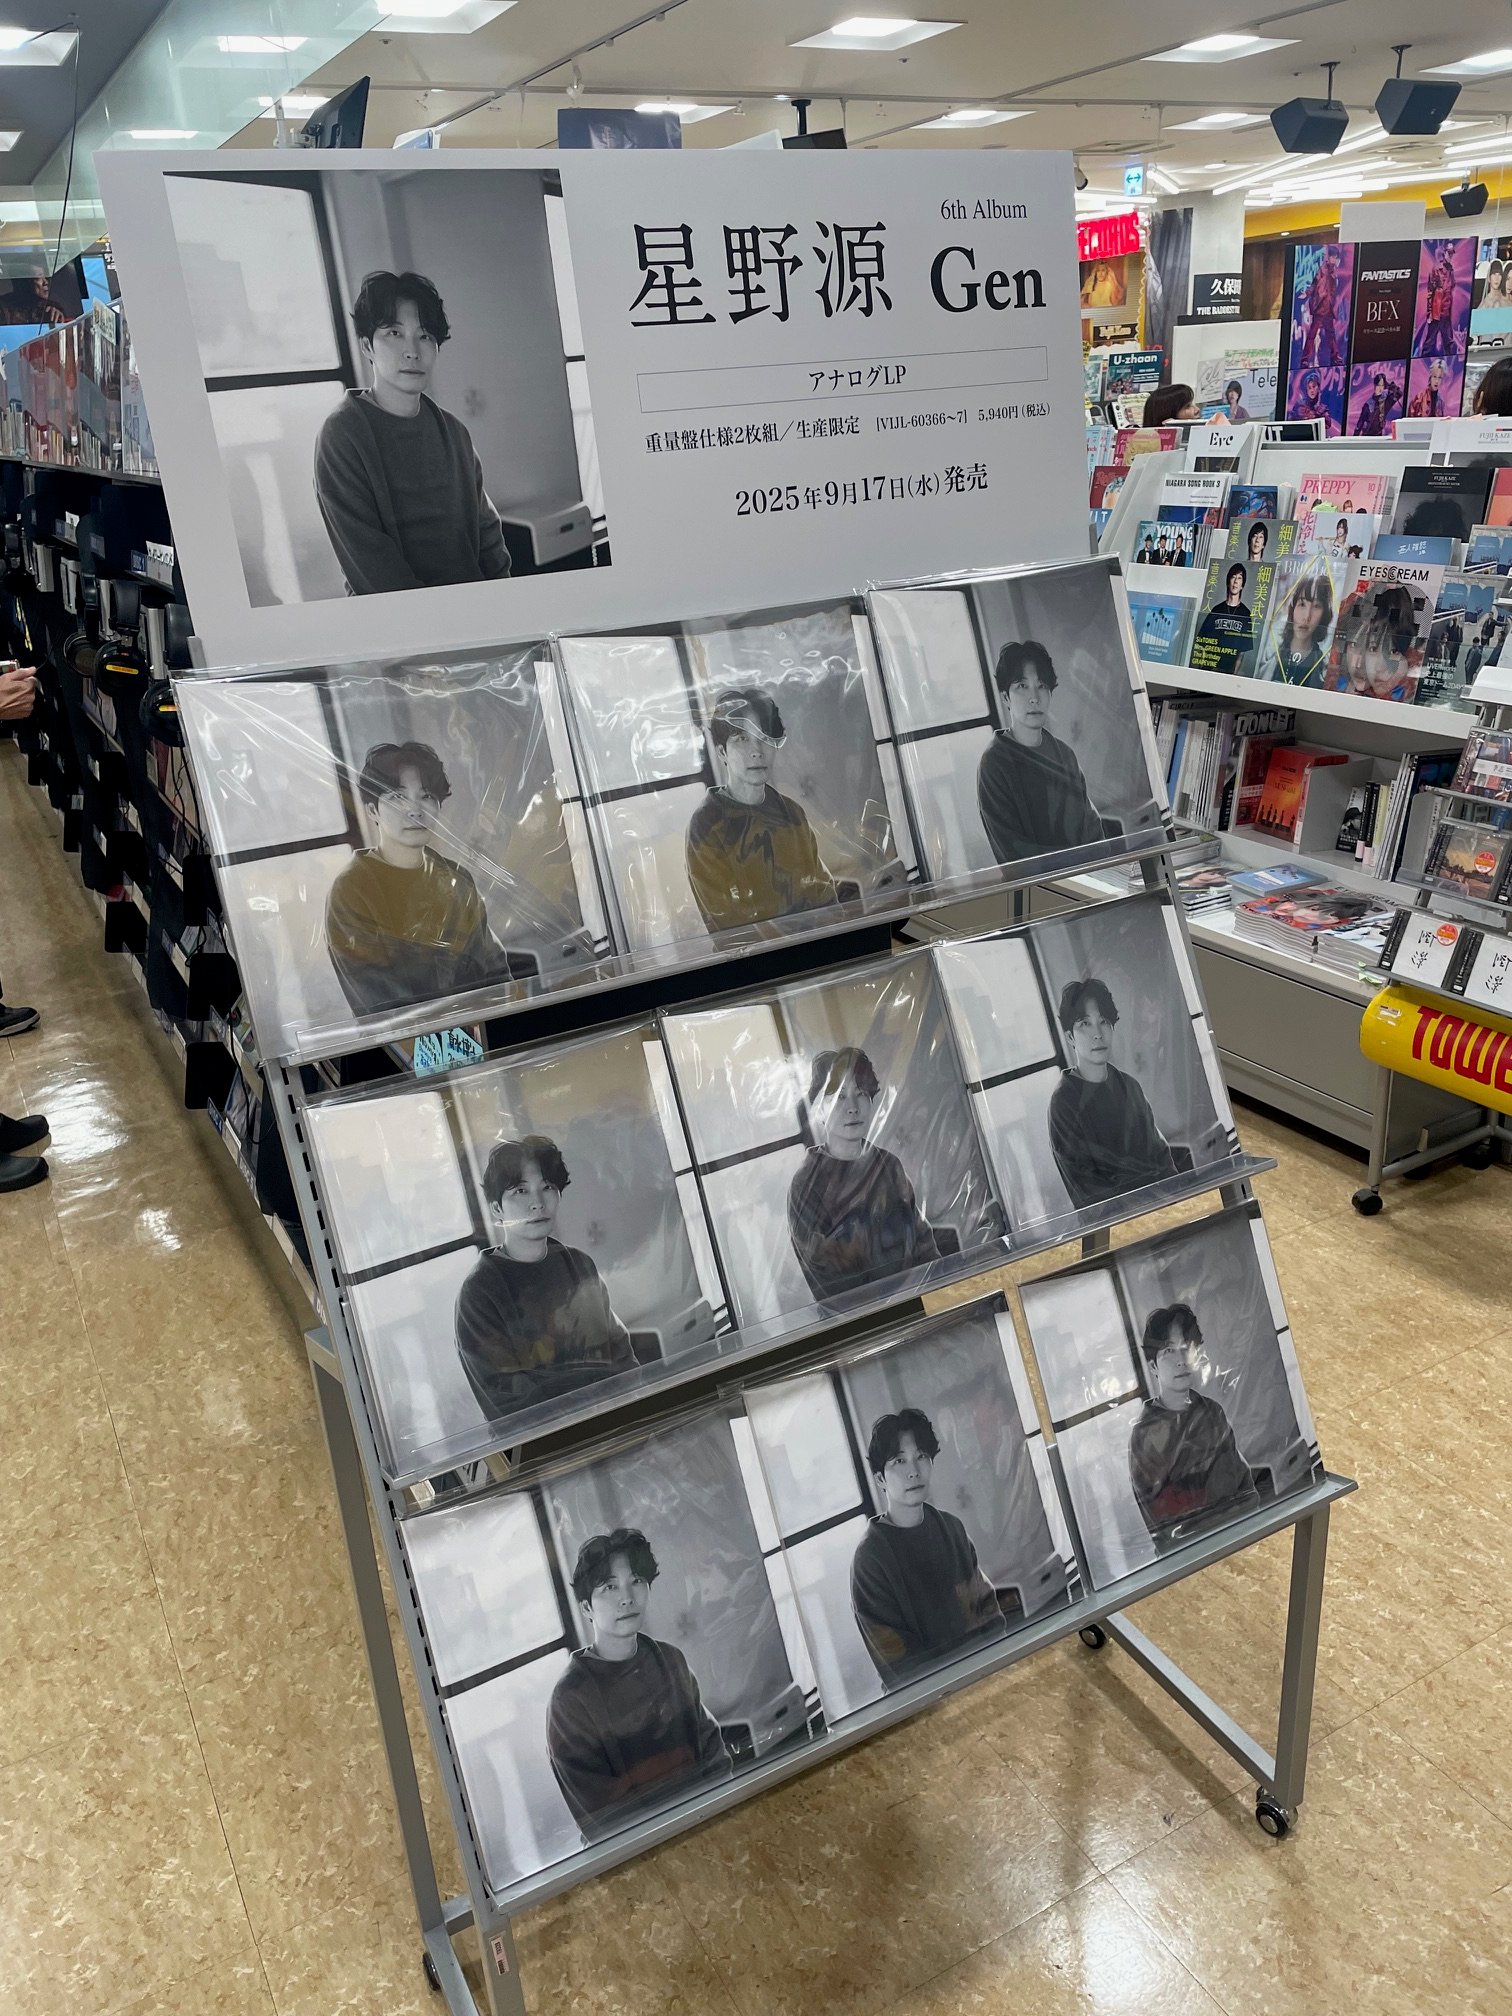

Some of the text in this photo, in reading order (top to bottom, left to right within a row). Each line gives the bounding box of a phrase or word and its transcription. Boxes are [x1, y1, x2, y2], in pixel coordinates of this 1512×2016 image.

[940, 198, 1028, 221] 6th Album
[629, 221, 1047, 328] 星野源 Gen
[1361, 269, 1411, 281] FANTASTICS
[1197, 306, 1211, 316] THE
[1113, 353, 1158, 366] U-zhaan
[809, 364, 907, 392] アナログLP
[1249, 367, 1277, 388] Tele
[735, 462, 989, 517] 2025年9月17日(水)発売
[1302, 479, 1355, 495] PREPPY
[1156, 524, 1194, 538] YOUNG
[1360, 564, 1430, 582] EYESCREAM
[1247, 565, 1273, 634] 細美武士
[1205, 644, 1221, 653] GREEN
[1221, 647, 1238, 656] APPLE
